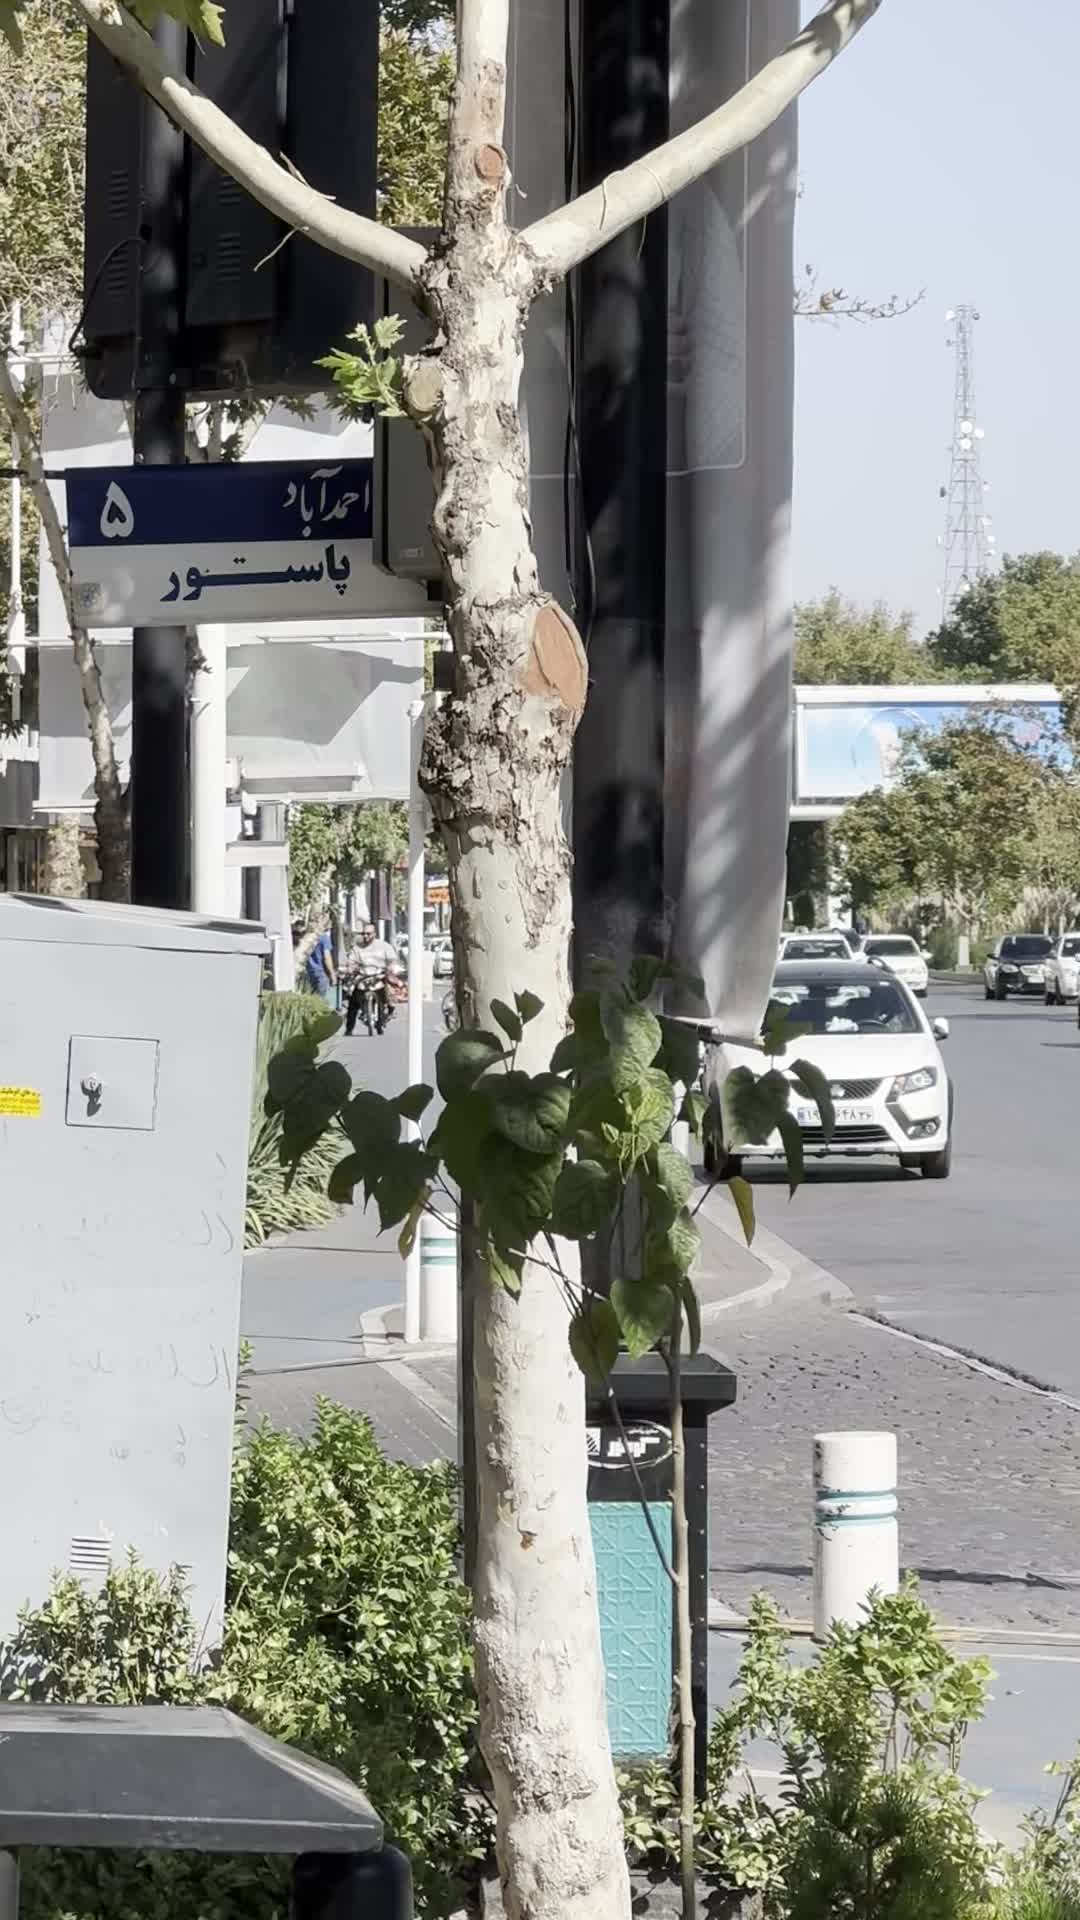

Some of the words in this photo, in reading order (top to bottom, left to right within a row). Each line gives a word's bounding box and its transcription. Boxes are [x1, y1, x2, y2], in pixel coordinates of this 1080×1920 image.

[100, 480, 134, 538] ۵
[282, 465, 370, 537] احمدآباد
[160, 544, 351, 601] پاستور
